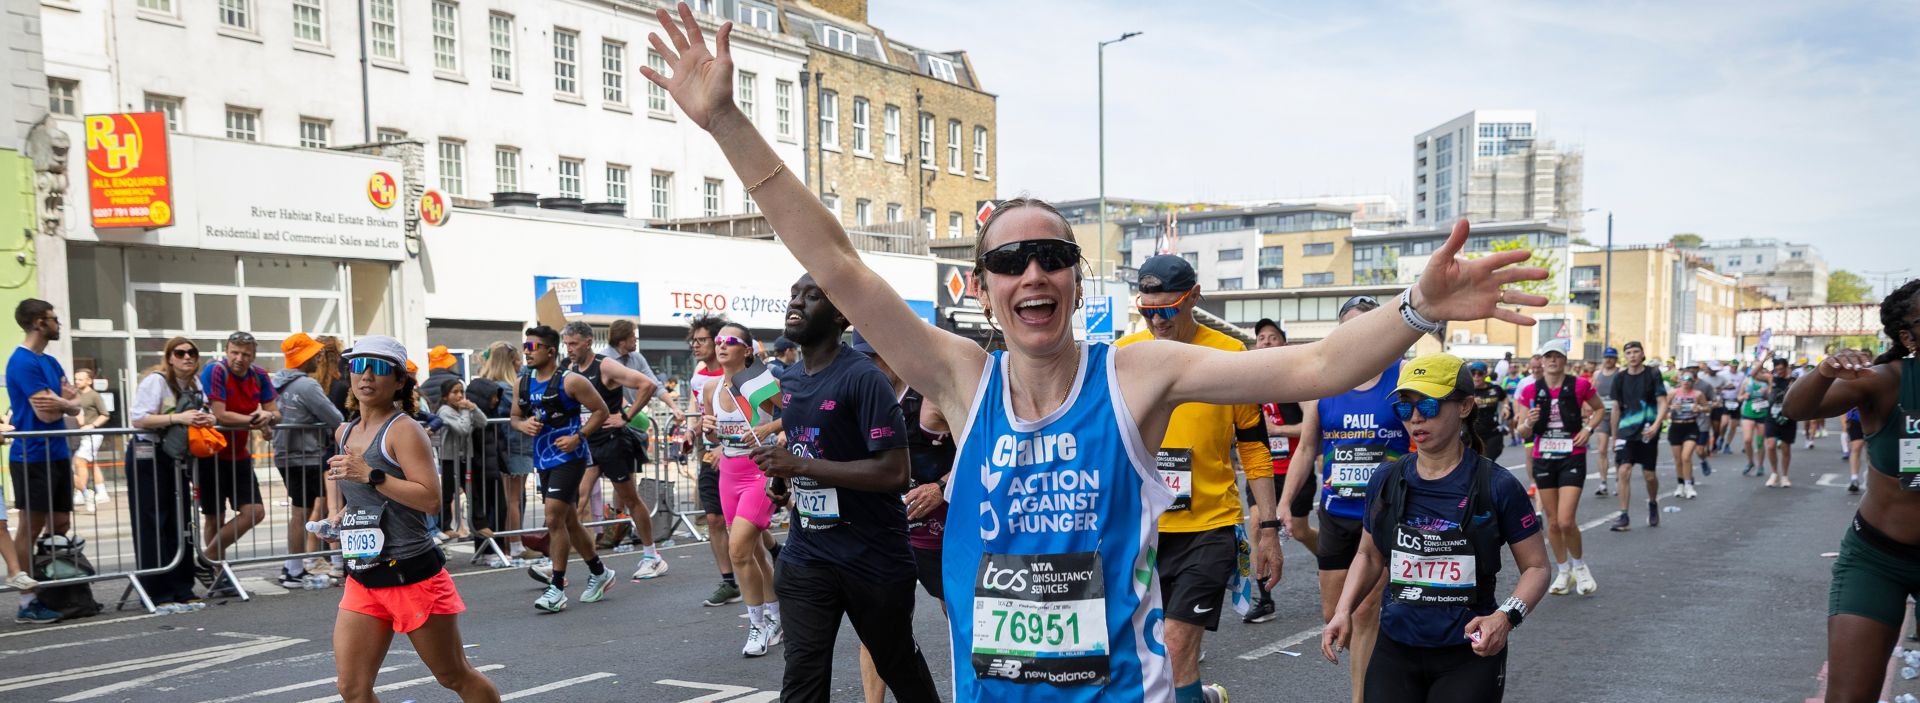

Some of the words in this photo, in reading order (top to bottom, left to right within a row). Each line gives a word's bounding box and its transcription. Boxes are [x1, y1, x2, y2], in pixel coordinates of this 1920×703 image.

[93, 179, 111, 188] ALL
[112, 176, 166, 188] ENQUIRIES
[251, 206, 277, 218] River
[280, 208, 313, 221] Habitat
[315, 211, 336, 224] Real
[338, 213, 364, 226] Estate
[367, 216, 399, 229] Brokers
[206, 225, 261, 240] Residential
[263, 230, 280, 242] and
[282, 231, 337, 245] Commercial
[340, 235, 362, 247] Sales
[365, 237, 380, 248] and
[382, 238, 399, 250] Lets
[671, 292, 726, 311] TESCO
[732, 295, 788, 318] express
[1413, 368, 1427, 376] OR
[1343, 413, 1379, 429] PAUL
[1378, 428, 1403, 439] Care
[992, 432, 1077, 468] Claire
[1334, 447, 1353, 461] tcs
[1007, 469, 1100, 496] ACTION
[1007, 493, 1099, 516] AGAINST
[1008, 512, 1098, 535] HUNGER
[1397, 527, 1421, 551] tcs
[1423, 539, 1467, 548] CONSULTANCY
[982, 561, 1029, 592] tcs
[1402, 560, 1461, 581] 21775
[1438, 595, 1469, 603] balance
[991, 610, 1080, 647] 76951
[1024, 670, 1047, 679] new
[1048, 670, 1096, 682] balance
